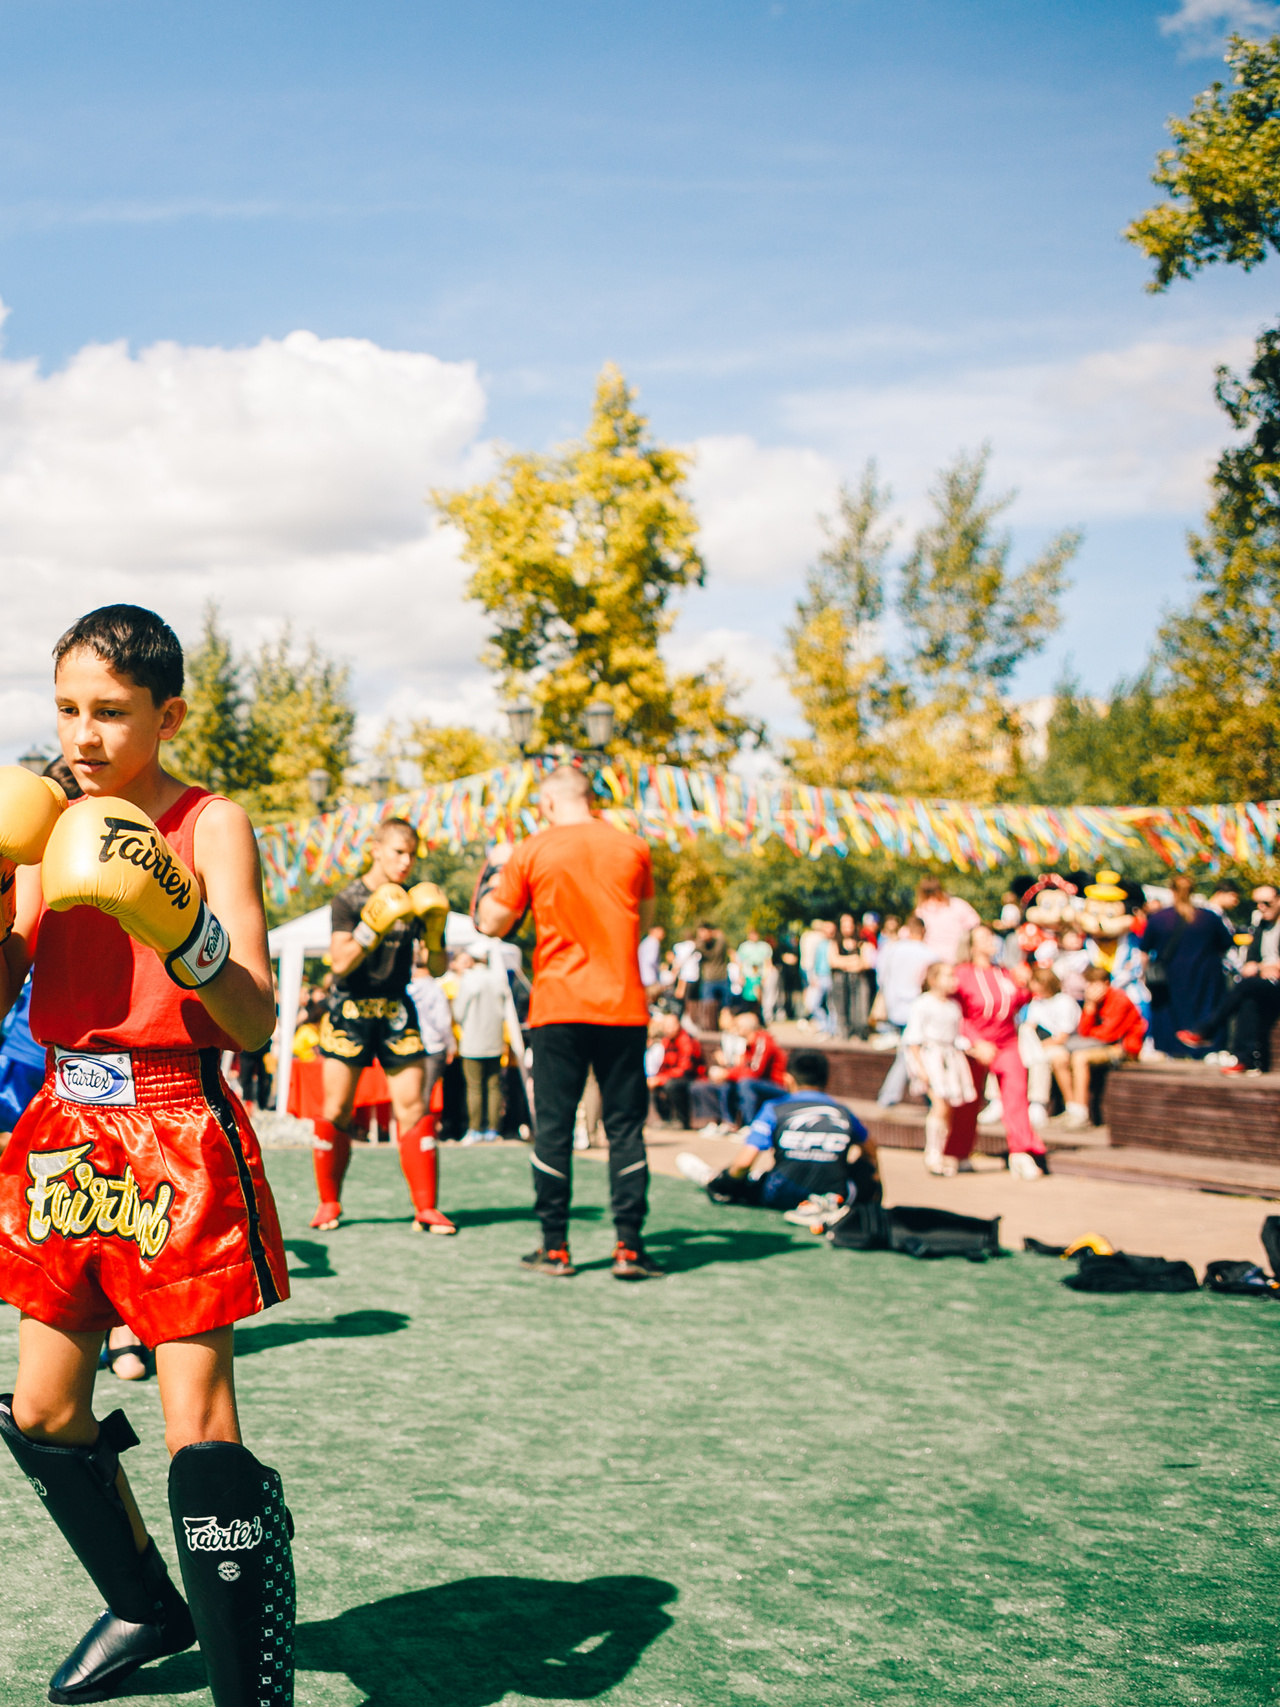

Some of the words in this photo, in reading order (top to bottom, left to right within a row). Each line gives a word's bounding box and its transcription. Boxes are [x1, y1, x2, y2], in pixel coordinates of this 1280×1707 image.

[99, 817, 192, 910] Fairtex
[65, 1063, 111, 1091] Fairtex
[183, 1516, 263, 1551] Fairtex
